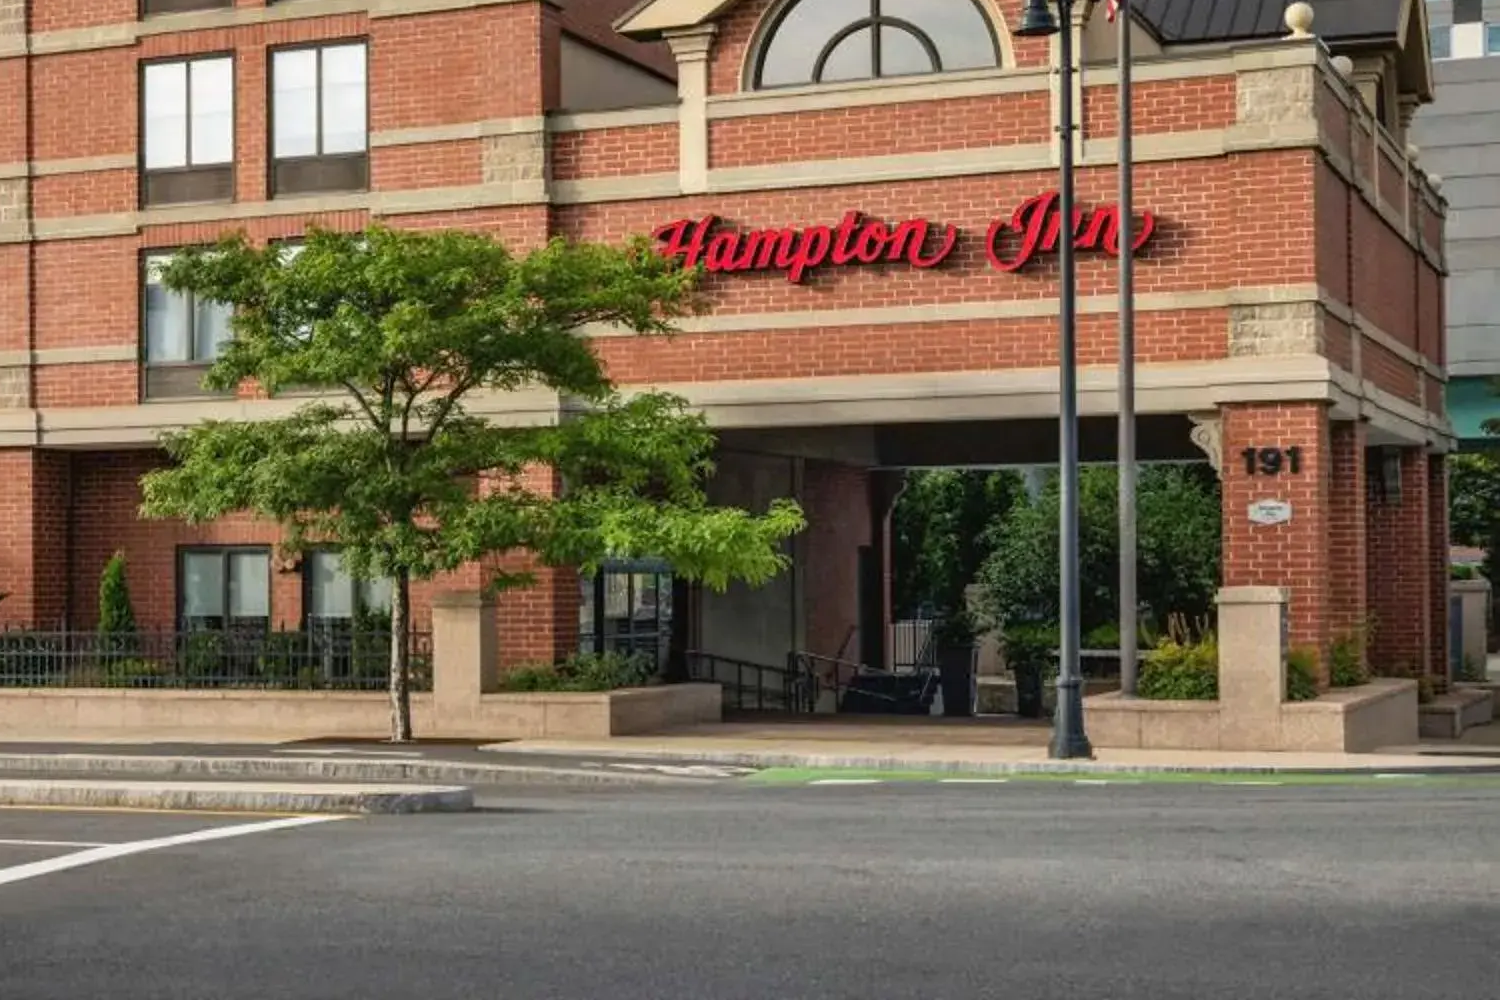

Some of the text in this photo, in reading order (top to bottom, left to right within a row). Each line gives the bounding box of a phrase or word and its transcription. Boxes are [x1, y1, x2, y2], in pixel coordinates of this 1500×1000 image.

[651, 189, 1154, 283] Hampton Inn
[1242, 446, 1300, 475] 191
